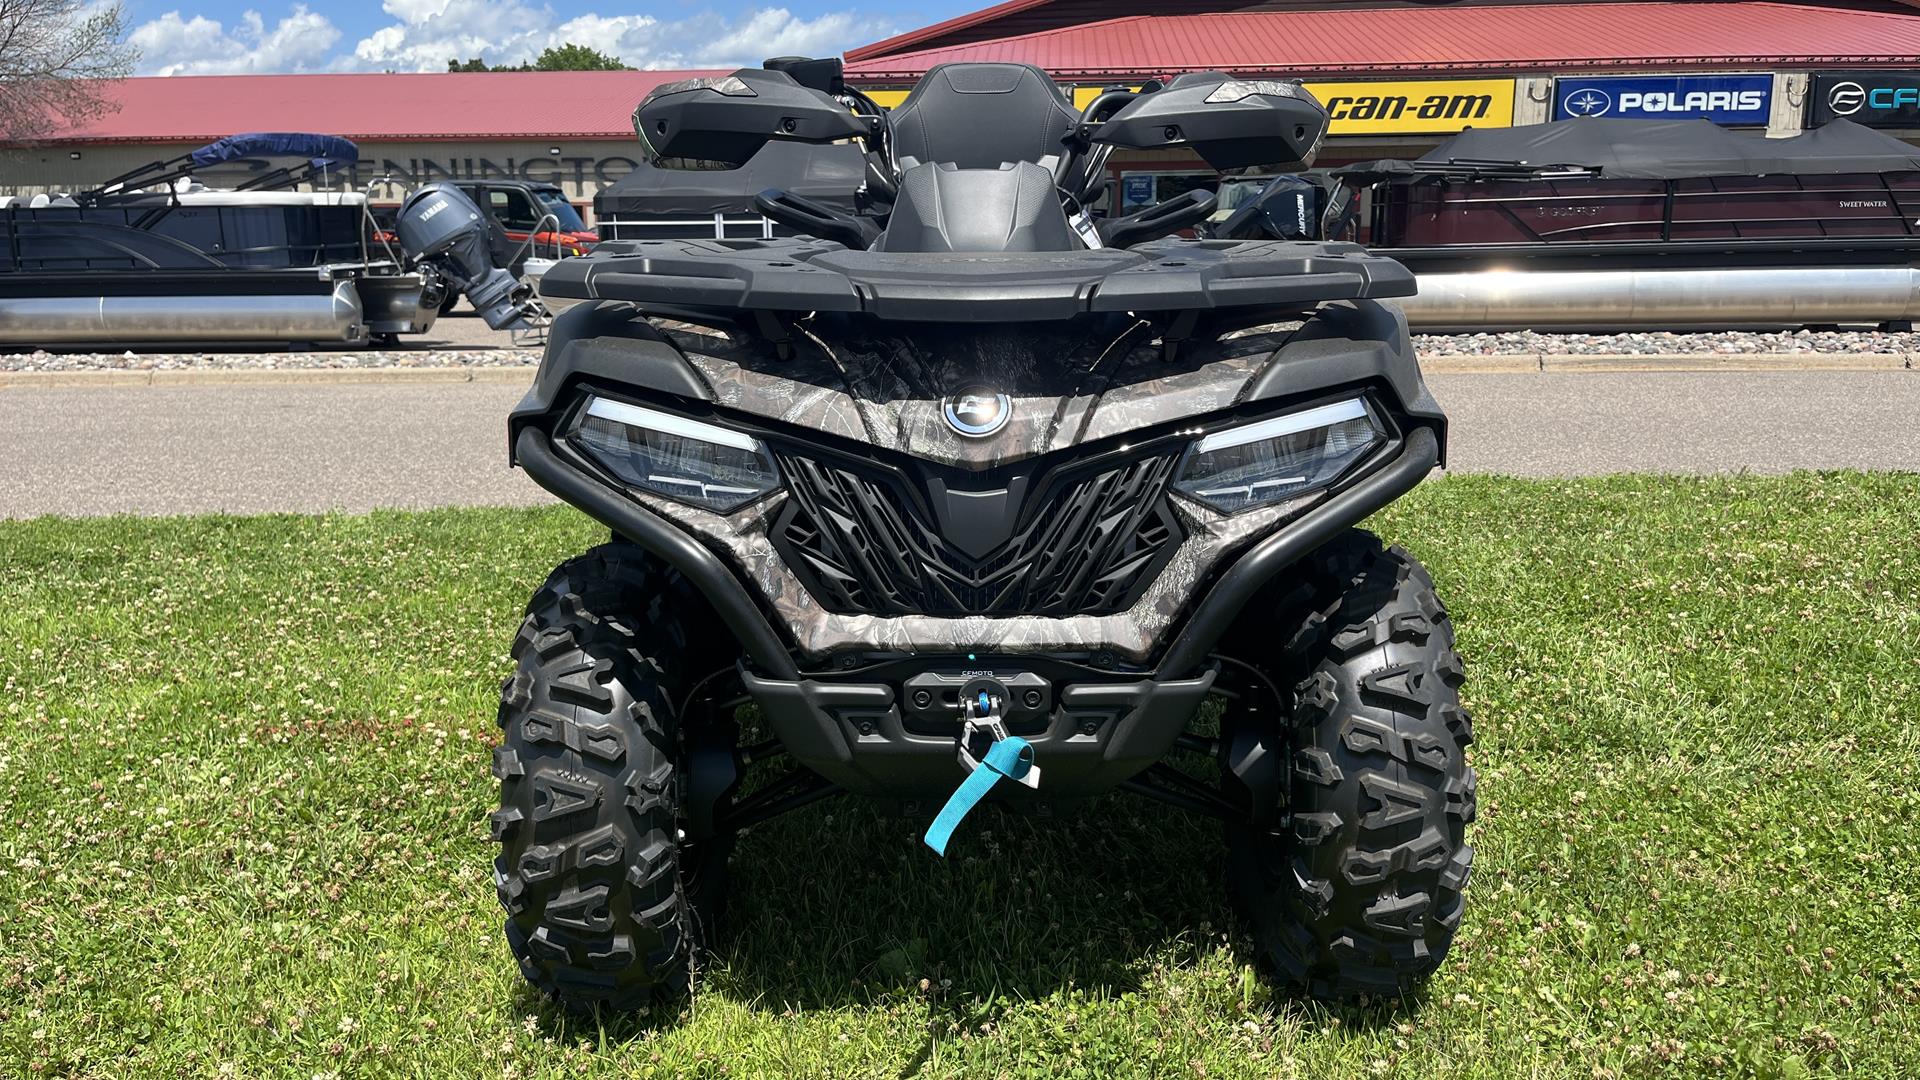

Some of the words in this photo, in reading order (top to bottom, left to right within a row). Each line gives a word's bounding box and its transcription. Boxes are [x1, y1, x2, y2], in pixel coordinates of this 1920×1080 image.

[1326, 94, 1492, 120] can-am
[1619, 91, 1762, 113] POLARIS
[1868, 88, 1920, 109] CF
[419, 199, 449, 222] YAMAHA
[1296, 193, 1306, 236] MERCURY
